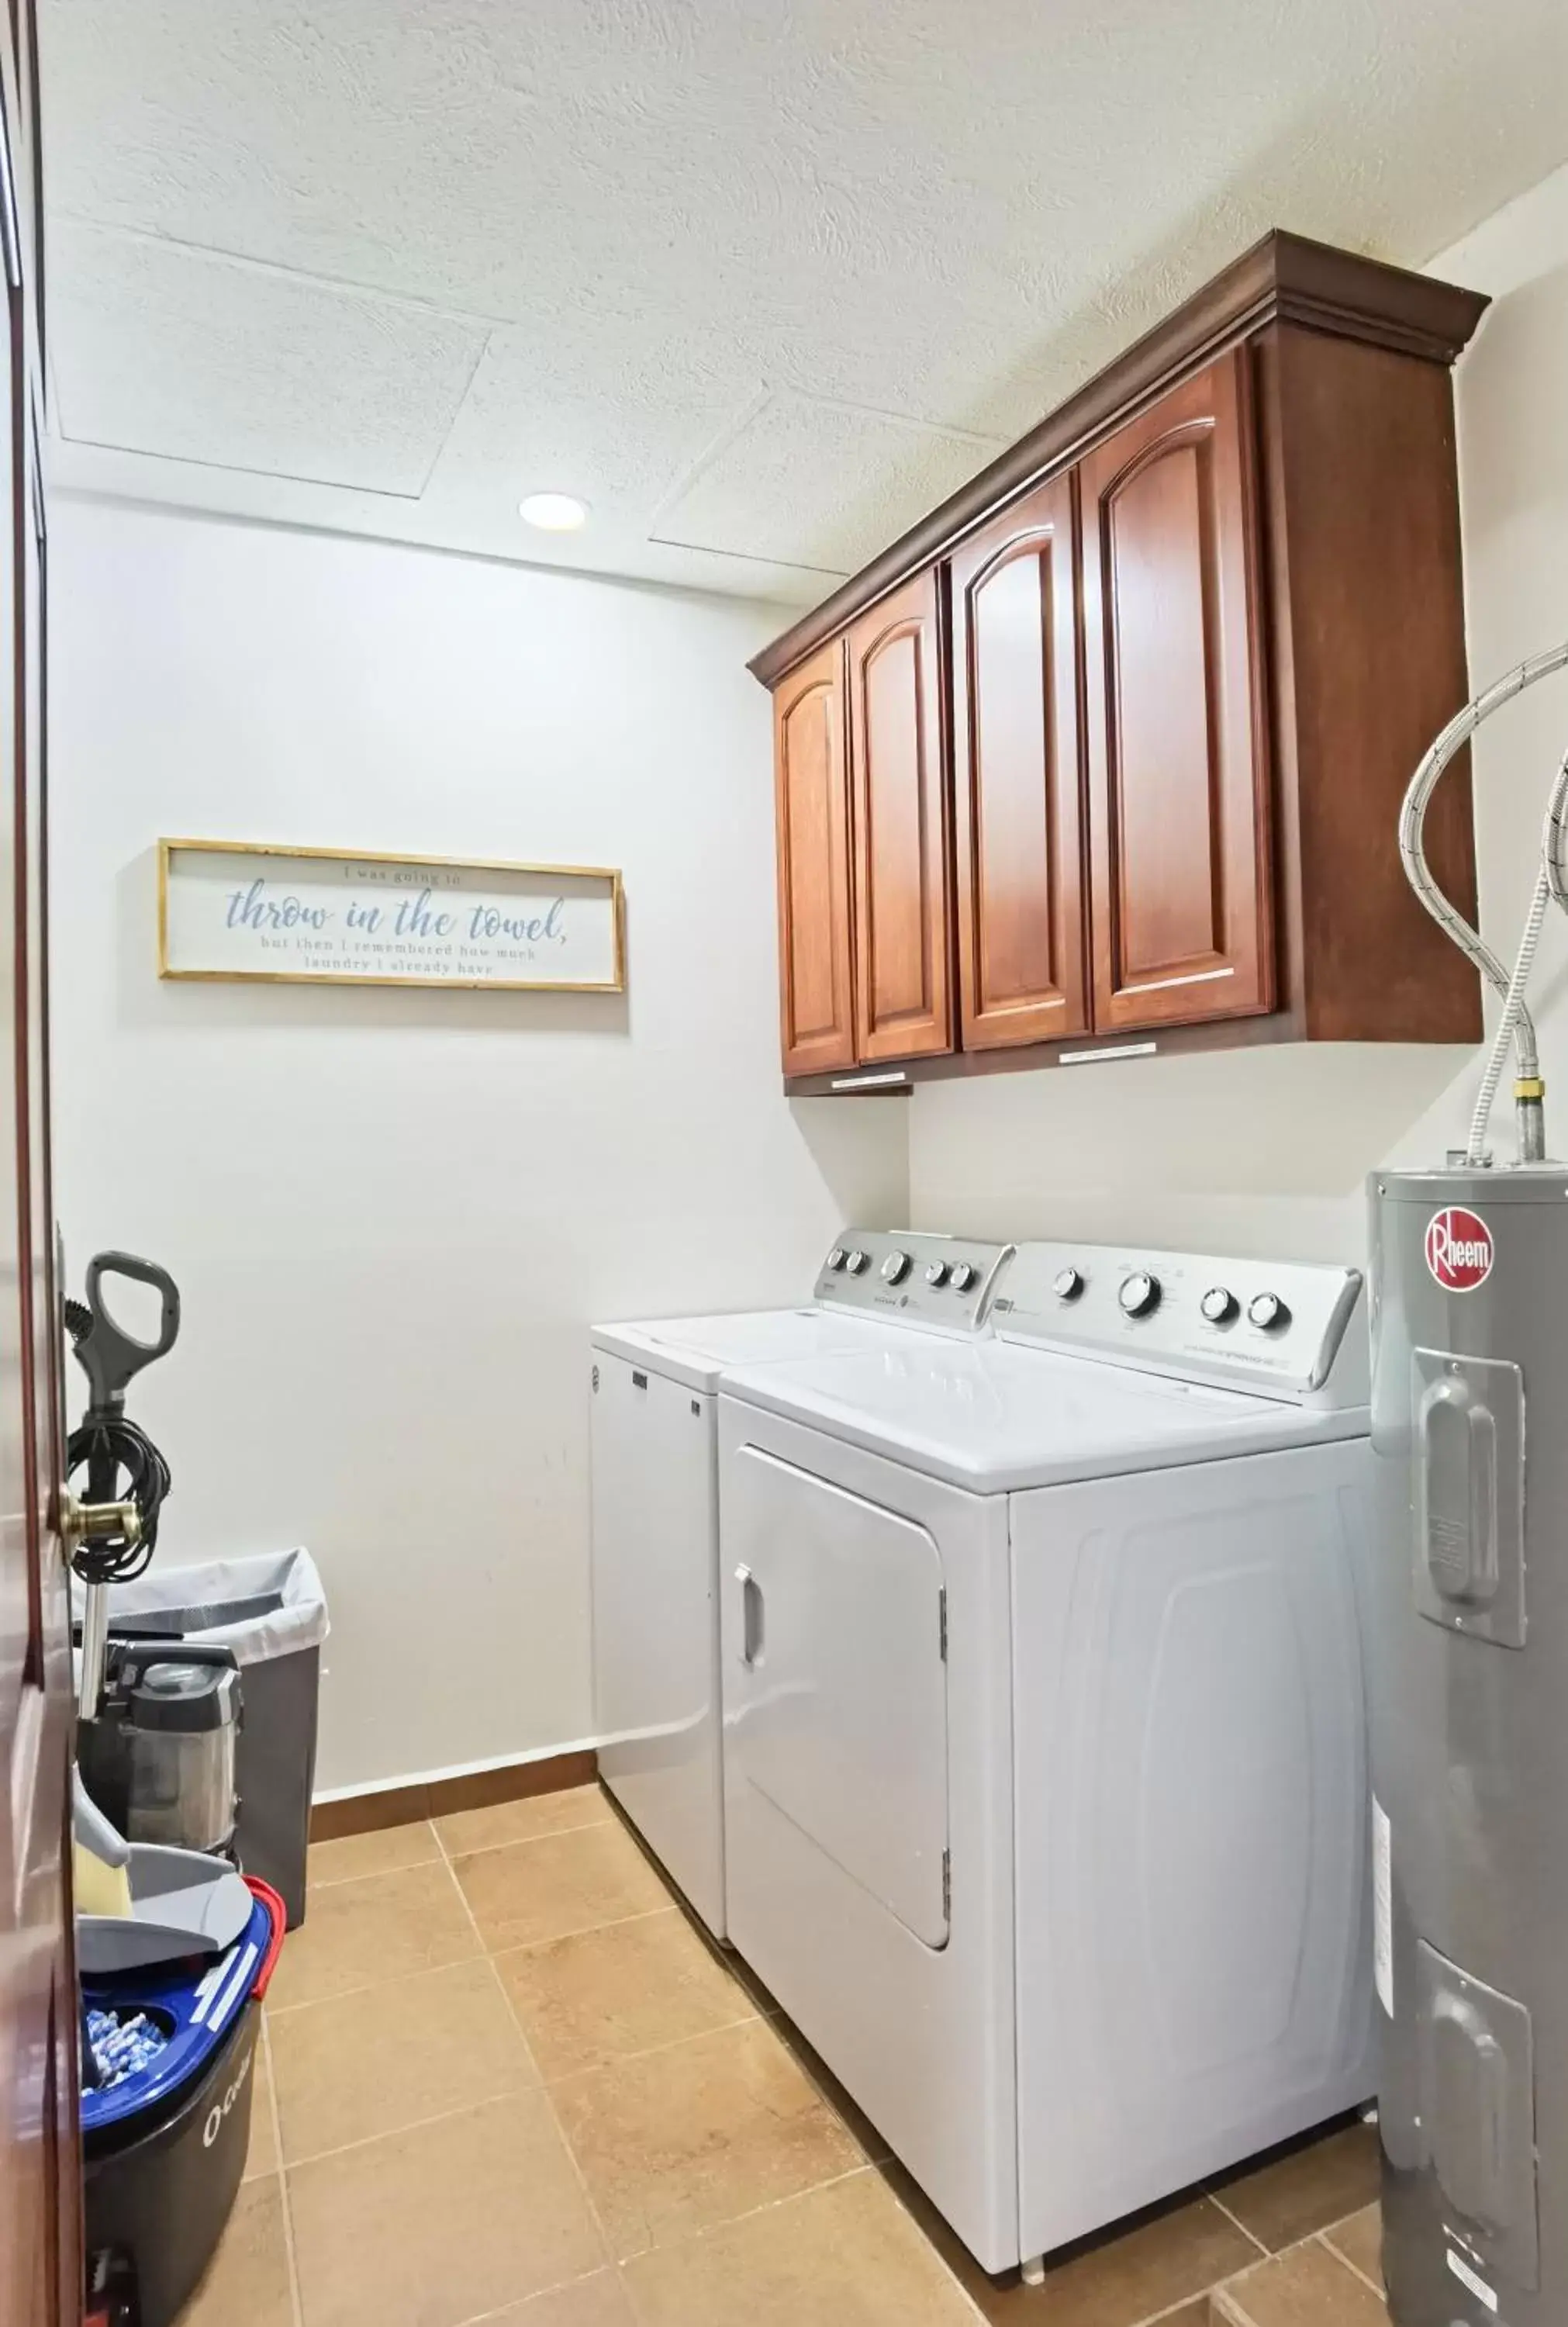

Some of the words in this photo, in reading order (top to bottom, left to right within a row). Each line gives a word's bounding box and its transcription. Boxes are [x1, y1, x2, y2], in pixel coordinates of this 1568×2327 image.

[357, 870, 385, 880] was
[394, 870, 439, 886] going
[446, 872, 461, 885] to
[225, 878, 335, 929] throw
[346, 901, 385, 934] in
[395, 888, 458, 938] the
[468, 896, 567, 945] towel,
[261, 935, 288, 949] but
[296, 937, 333, 951] then
[341, 939, 347, 952] I
[354, 940, 453, 956] remembered
[460, 943, 489, 957] how
[497, 946, 535, 961] much
[305, 956, 370, 970] laundry
[390, 959, 451, 976] already
[458, 962, 493, 975] have
[1432, 1209, 1489, 1278] Rheem
